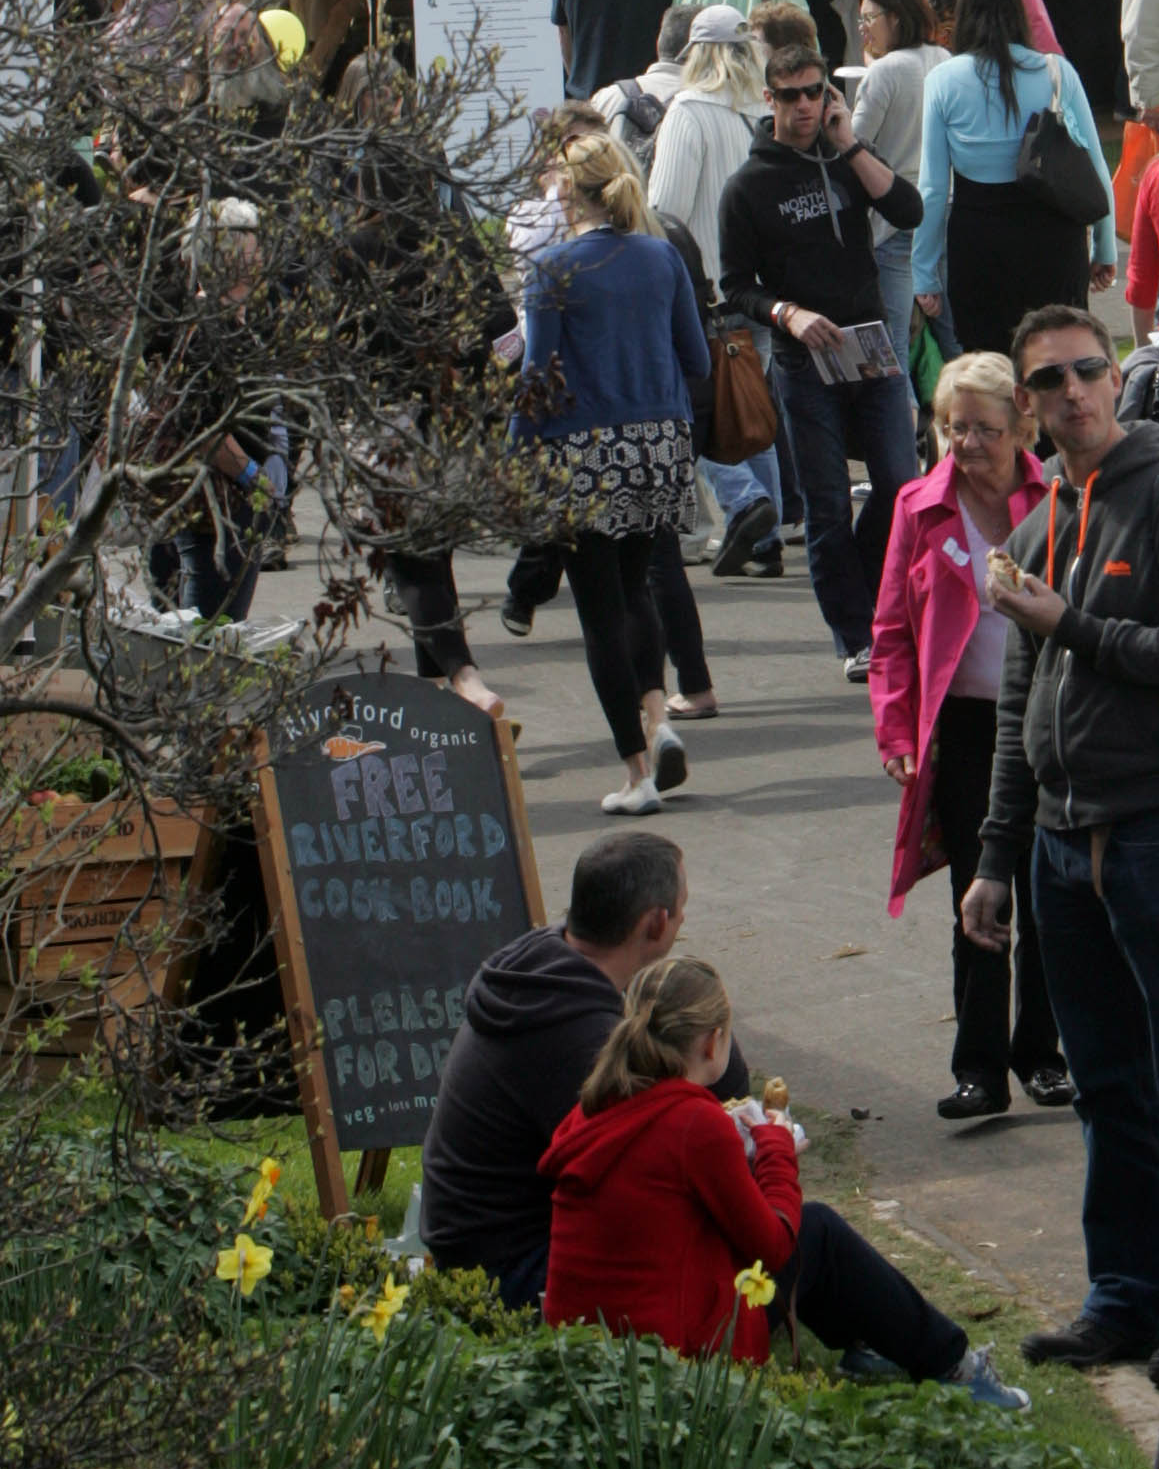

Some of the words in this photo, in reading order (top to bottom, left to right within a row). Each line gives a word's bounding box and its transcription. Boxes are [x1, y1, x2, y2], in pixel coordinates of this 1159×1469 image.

[778, 190, 826, 216] NORTH
[795, 202, 829, 222] FACE
[285, 695, 404, 741] Rivford
[410, 729, 477, 748] organic
[331, 750, 455, 821] FREE
[291, 813, 506, 867] RIVERFORD
[410, 876, 502, 923] BOOK
[334, 1040, 403, 1089] FOR
[344, 1106, 375, 1125] veg
[414, 1095, 438, 1108] mo
